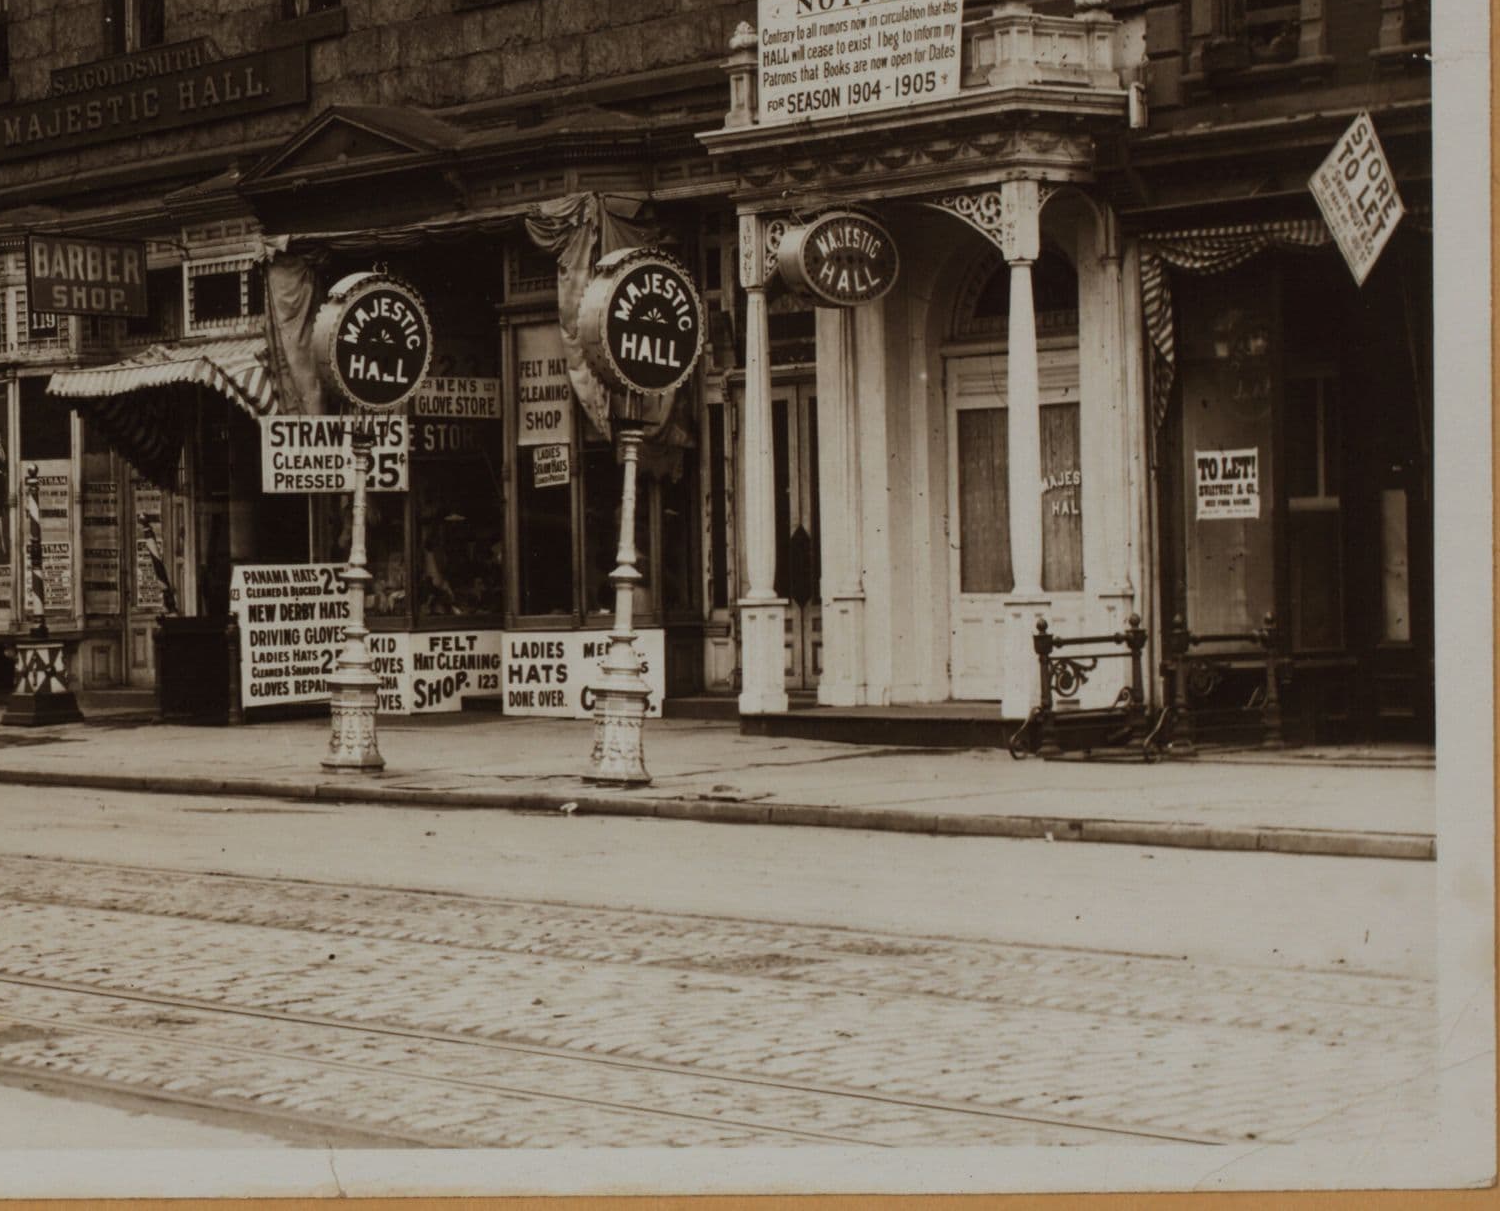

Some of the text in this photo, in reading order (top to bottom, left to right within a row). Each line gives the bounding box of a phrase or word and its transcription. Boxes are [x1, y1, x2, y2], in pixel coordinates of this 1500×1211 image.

[762, 0, 958, 46] Contrary to all rumors now in circulation that this
[763, 48, 790, 68] HALL
[792, 46, 805, 62] will
[807, 43, 833, 59] cease
[836, 39, 845, 54] to
[848, 36, 871, 53] exist
[883, 30, 899, 51] beg
[902, 27, 912, 44] to
[914, 24, 941, 40] inform
[944, 22, 956, 40] my
[763, 44, 955, 88] Patrons that Books are now open for Dates
[767, 98, 785, 113] FOR
[787, 87, 840, 114] SEASON
[848, 80, 881, 106] 1904
[895, 71, 936, 97] 1905
[4, 67, 270, 146] MAJESTIC HALL.
[1351, 123, 1396, 220] STORE
[1338, 141, 1360, 181] TO
[1356, 185, 1386, 237] LET
[816, 226, 881, 259] MAJESTIC
[33, 242, 142, 284] BARBER
[820, 261, 881, 292] HALL
[52, 285, 129, 312] SHOP.
[614, 273, 692, 331] MAJESTIC
[31, 313, 55, 330] 119
[344, 297, 420, 350] MAJESTIC
[621, 332, 680, 368] HALL
[519, 358, 568, 378] FELT HAT
[436, 379, 477, 393] MENS
[519, 385, 569, 402] CLEANING
[420, 396, 495, 415] GLOVE STORE
[526, 411, 561, 429] SHOP
[270, 421, 346, 447] STRAW
[273, 452, 344, 470] CLEANED
[537, 447, 561, 460] LADIES
[1198, 456, 1256, 481] TO LET!
[274, 472, 345, 489] PRESSED
[1052, 500, 1079, 515] HAL
[243, 567, 349, 595] PANAMA HATS 25
[246, 587, 281, 599] CLEANED
[248, 601, 350, 623] NEW DERBY HATS
[250, 626, 348, 647] DRIVING GLOVES
[370, 638, 396, 653] KID
[429, 635, 478, 652] FELT
[252, 651, 290, 664] LADIES
[293, 649, 318, 662] HATS
[511, 641, 565, 659] LADIES
[413, 652, 500, 670] HAT CLEANING
[252, 666, 283, 678] CLEANED
[292, 665, 320, 676] SHAPED
[508, 664, 568, 684] HATS
[250, 681, 289, 697] GLOVES
[414, 671, 498, 709] SHOP. 123
[509, 690, 534, 707] DONE
[539, 690, 568, 708] OVER.
